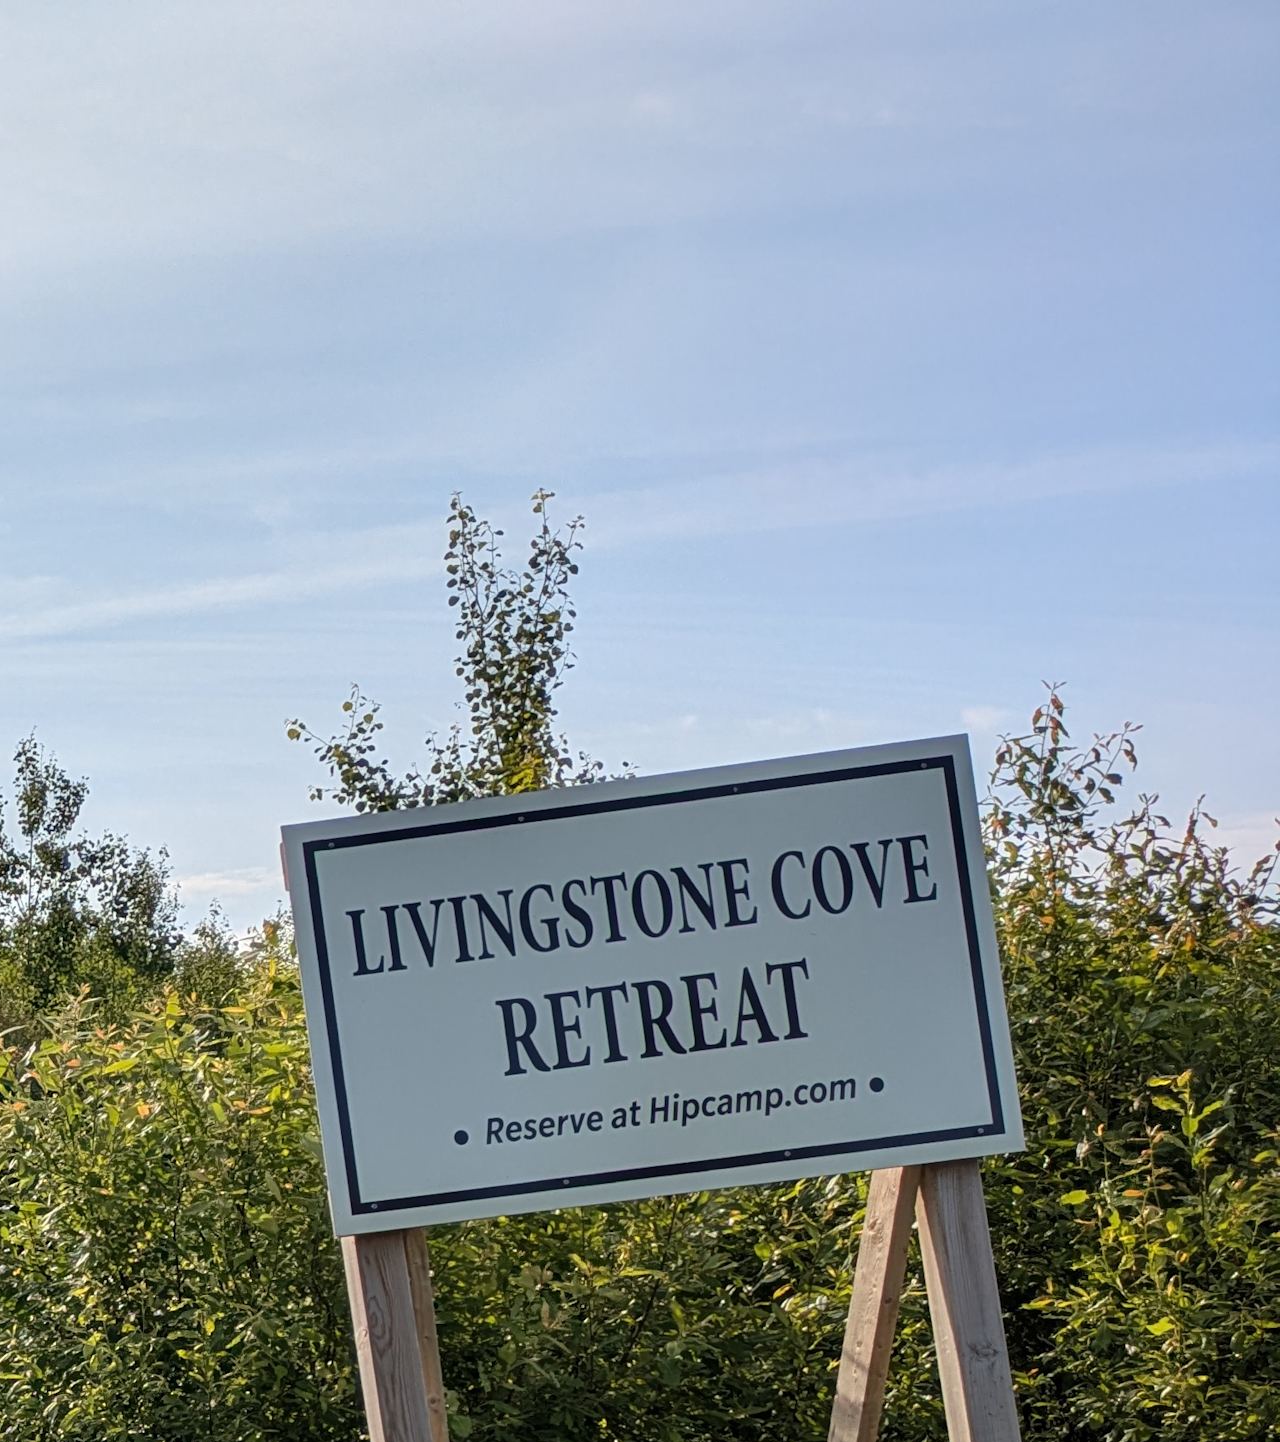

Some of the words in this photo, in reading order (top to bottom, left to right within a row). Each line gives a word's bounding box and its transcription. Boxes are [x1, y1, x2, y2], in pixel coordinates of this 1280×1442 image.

[344, 857, 759, 977] LIVINGSTONE
[769, 833, 939, 920] COVE
[494, 957, 810, 1077] RETREAT
[485, 1110, 604, 1145] Reserve
[611, 1100, 642, 1129] at
[648, 1077, 857, 1127] Hipcamp.com
